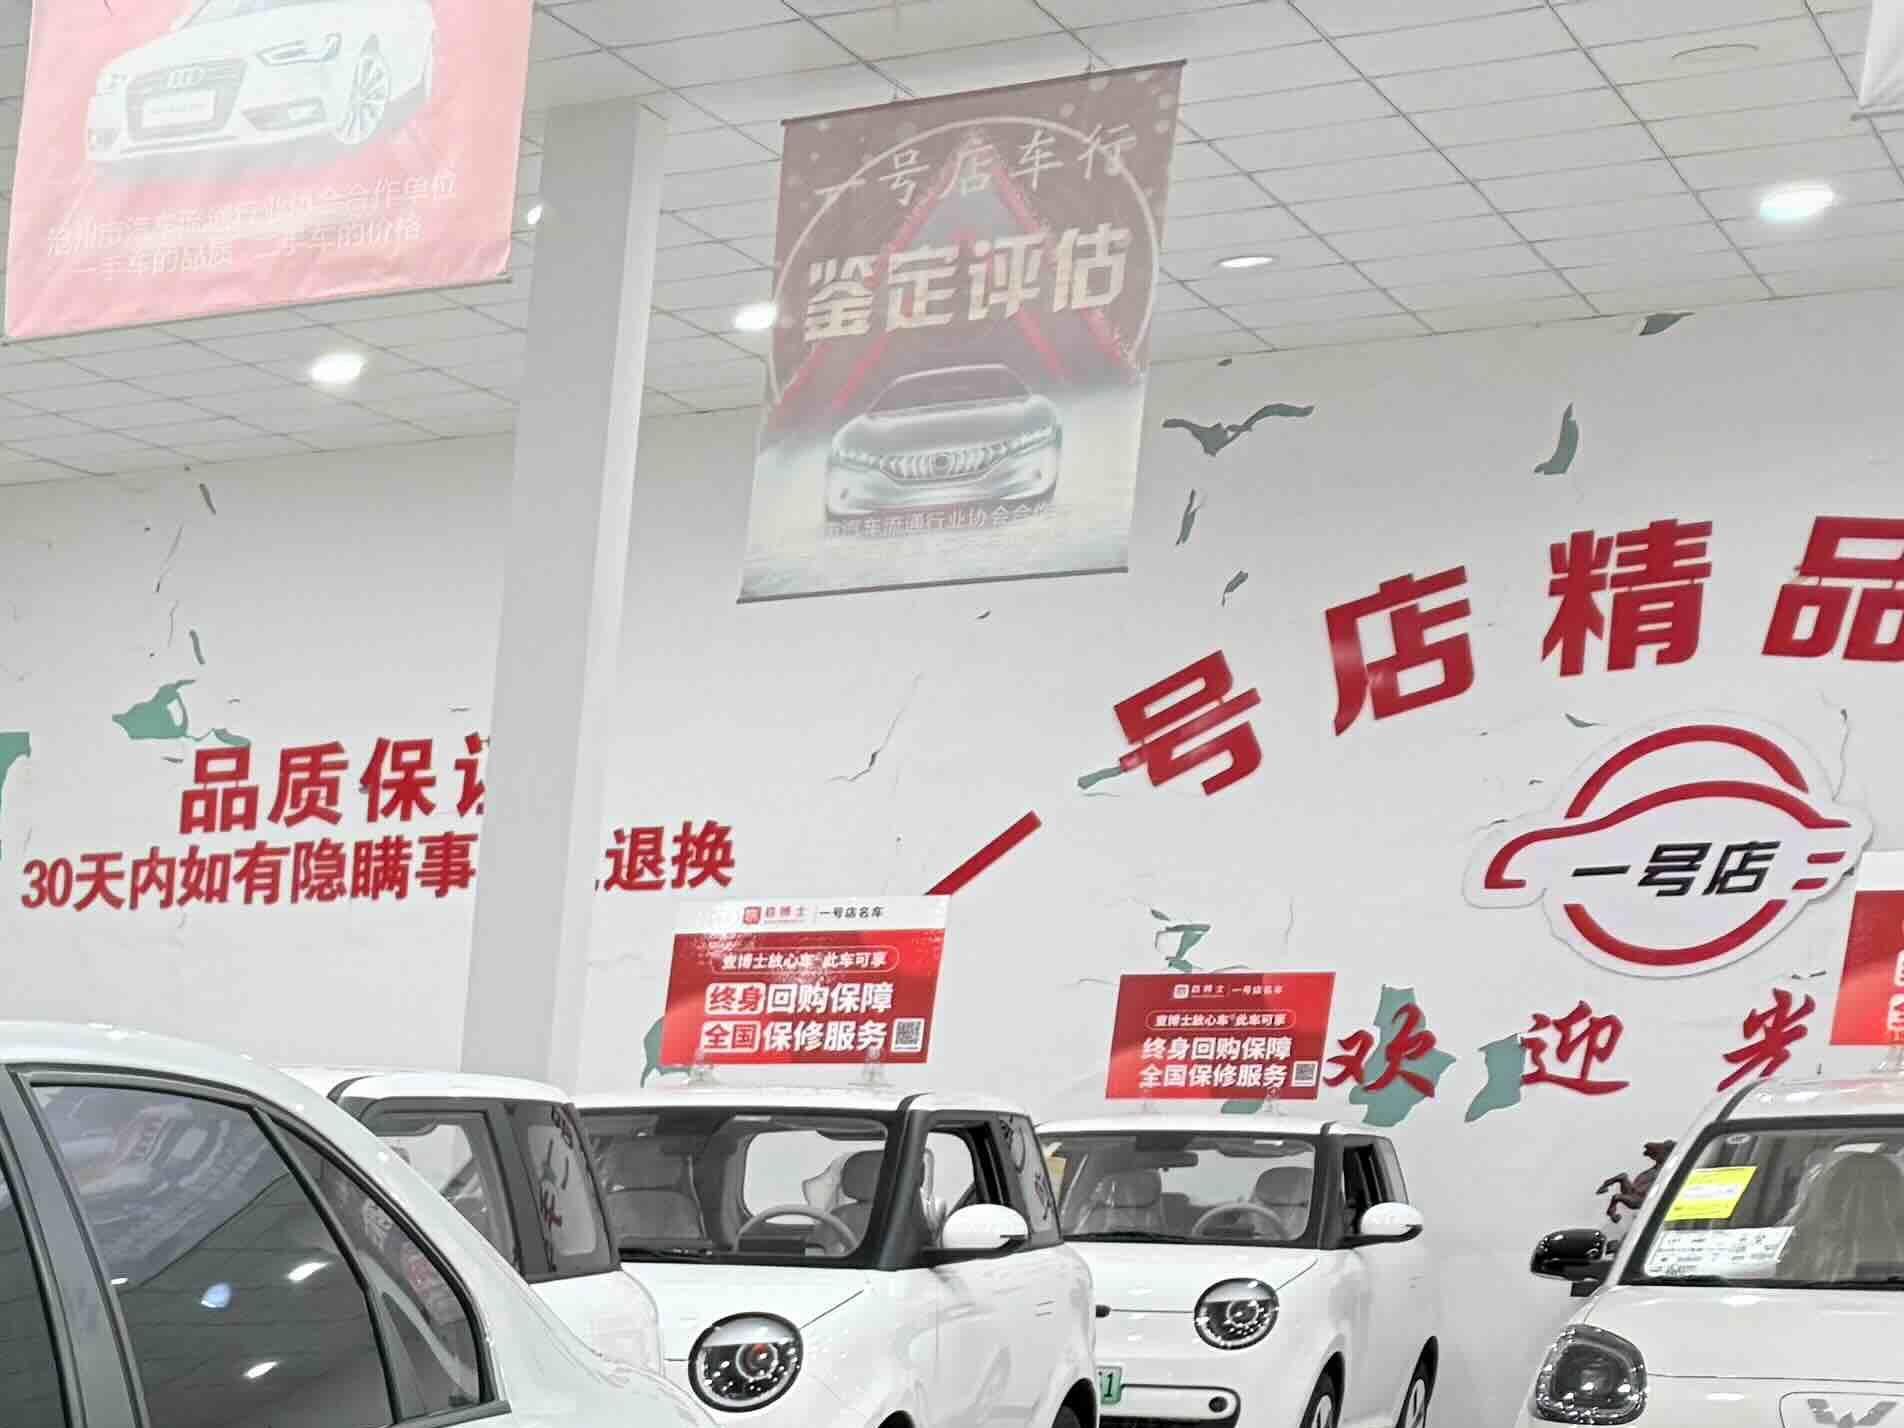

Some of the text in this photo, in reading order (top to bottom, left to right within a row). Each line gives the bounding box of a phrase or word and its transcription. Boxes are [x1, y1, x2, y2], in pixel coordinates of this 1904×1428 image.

[804, 222, 1132, 343] 鉴定评估
[20, 819, 737, 912] 30天内如有隐瞒事 退换
[1572, 839, 1782, 898] 一号店
[709, 982, 895, 1015] 终身回购保障
[704, 1020, 888, 1052] 全国保修服务
[1142, 1036, 1294, 1061] 终身回购保障
[1139, 1063, 1289, 1089] 全国保修服务
